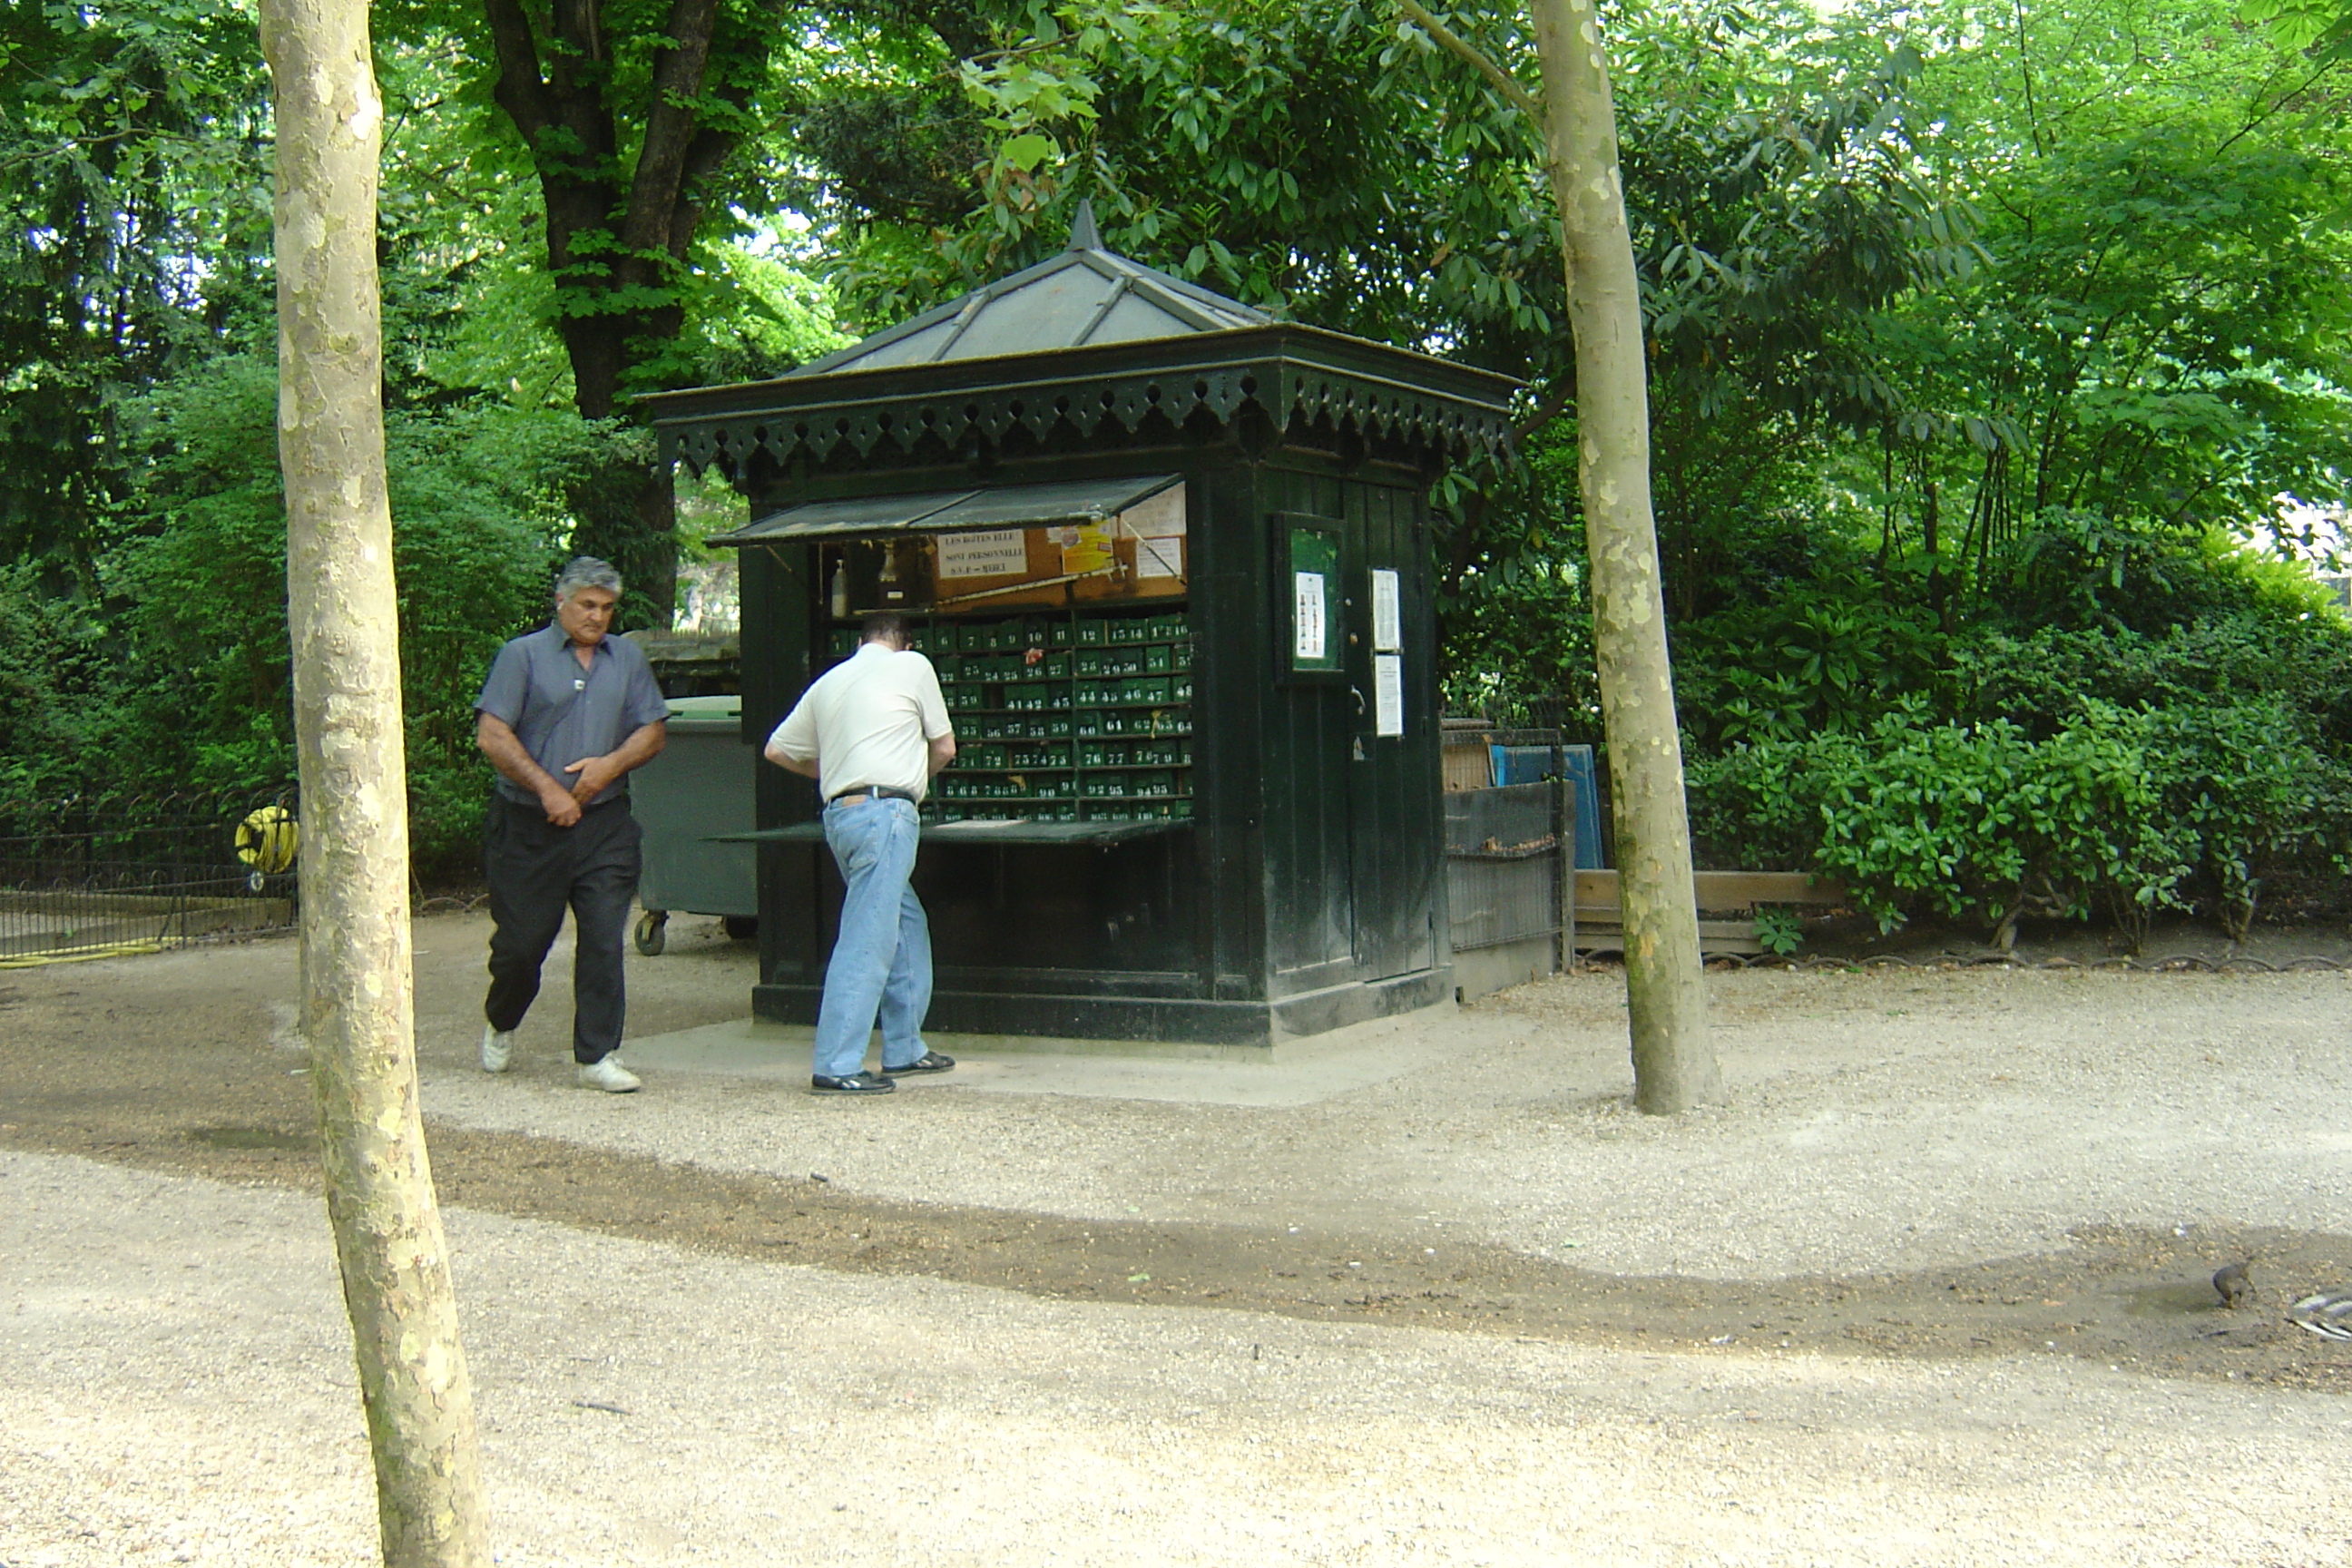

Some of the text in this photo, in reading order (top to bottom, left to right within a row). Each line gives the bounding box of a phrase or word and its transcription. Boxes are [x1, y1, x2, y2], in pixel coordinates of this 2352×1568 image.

[916, 639, 923, 649] 5
[941, 636, 948, 645] 6
[968, 636, 975, 646] 7
[990, 637, 996, 647] 8
[1008, 633, 1015, 643] 9
[1029, 632, 1042, 642] 10
[1056, 630, 1065, 640] 11
[1082, 630, 1095, 641] 12
[1131, 628, 1142, 639] 14
[1026, 667, 1042, 677] 26
[1049, 664, 1062, 675] 27
[1103, 664, 1121, 674] 29
[1006, 700, 1022, 710] 41
[1026, 699, 1042, 709] 42
[1053, 697, 1070, 708] 43
[1079, 691, 1095, 702] 44
[1124, 688, 1141, 700] 46
[1147, 691, 1162, 701] 47
[1177, 684, 1192, 697] 48
[987, 729, 1001, 738] 56
[1007, 722, 1022, 734] 57
[1030, 726, 1044, 737] 58
[1053, 722, 1068, 732] 59
[1079, 725, 1096, 735] 60
[1106, 720, 1122, 731] 61
[1134, 720, 1151, 729] 62
[1178, 721, 1192, 732] 64
[985, 755, 1001, 766] 72
[1085, 753, 1101, 764] 76
[1109, 753, 1124, 764] 77
[1153, 753, 1171, 764] 79
[1038, 788, 1055, 798] 90
[1088, 785, 1104, 795] 92
[1137, 787, 1152, 797] 94
